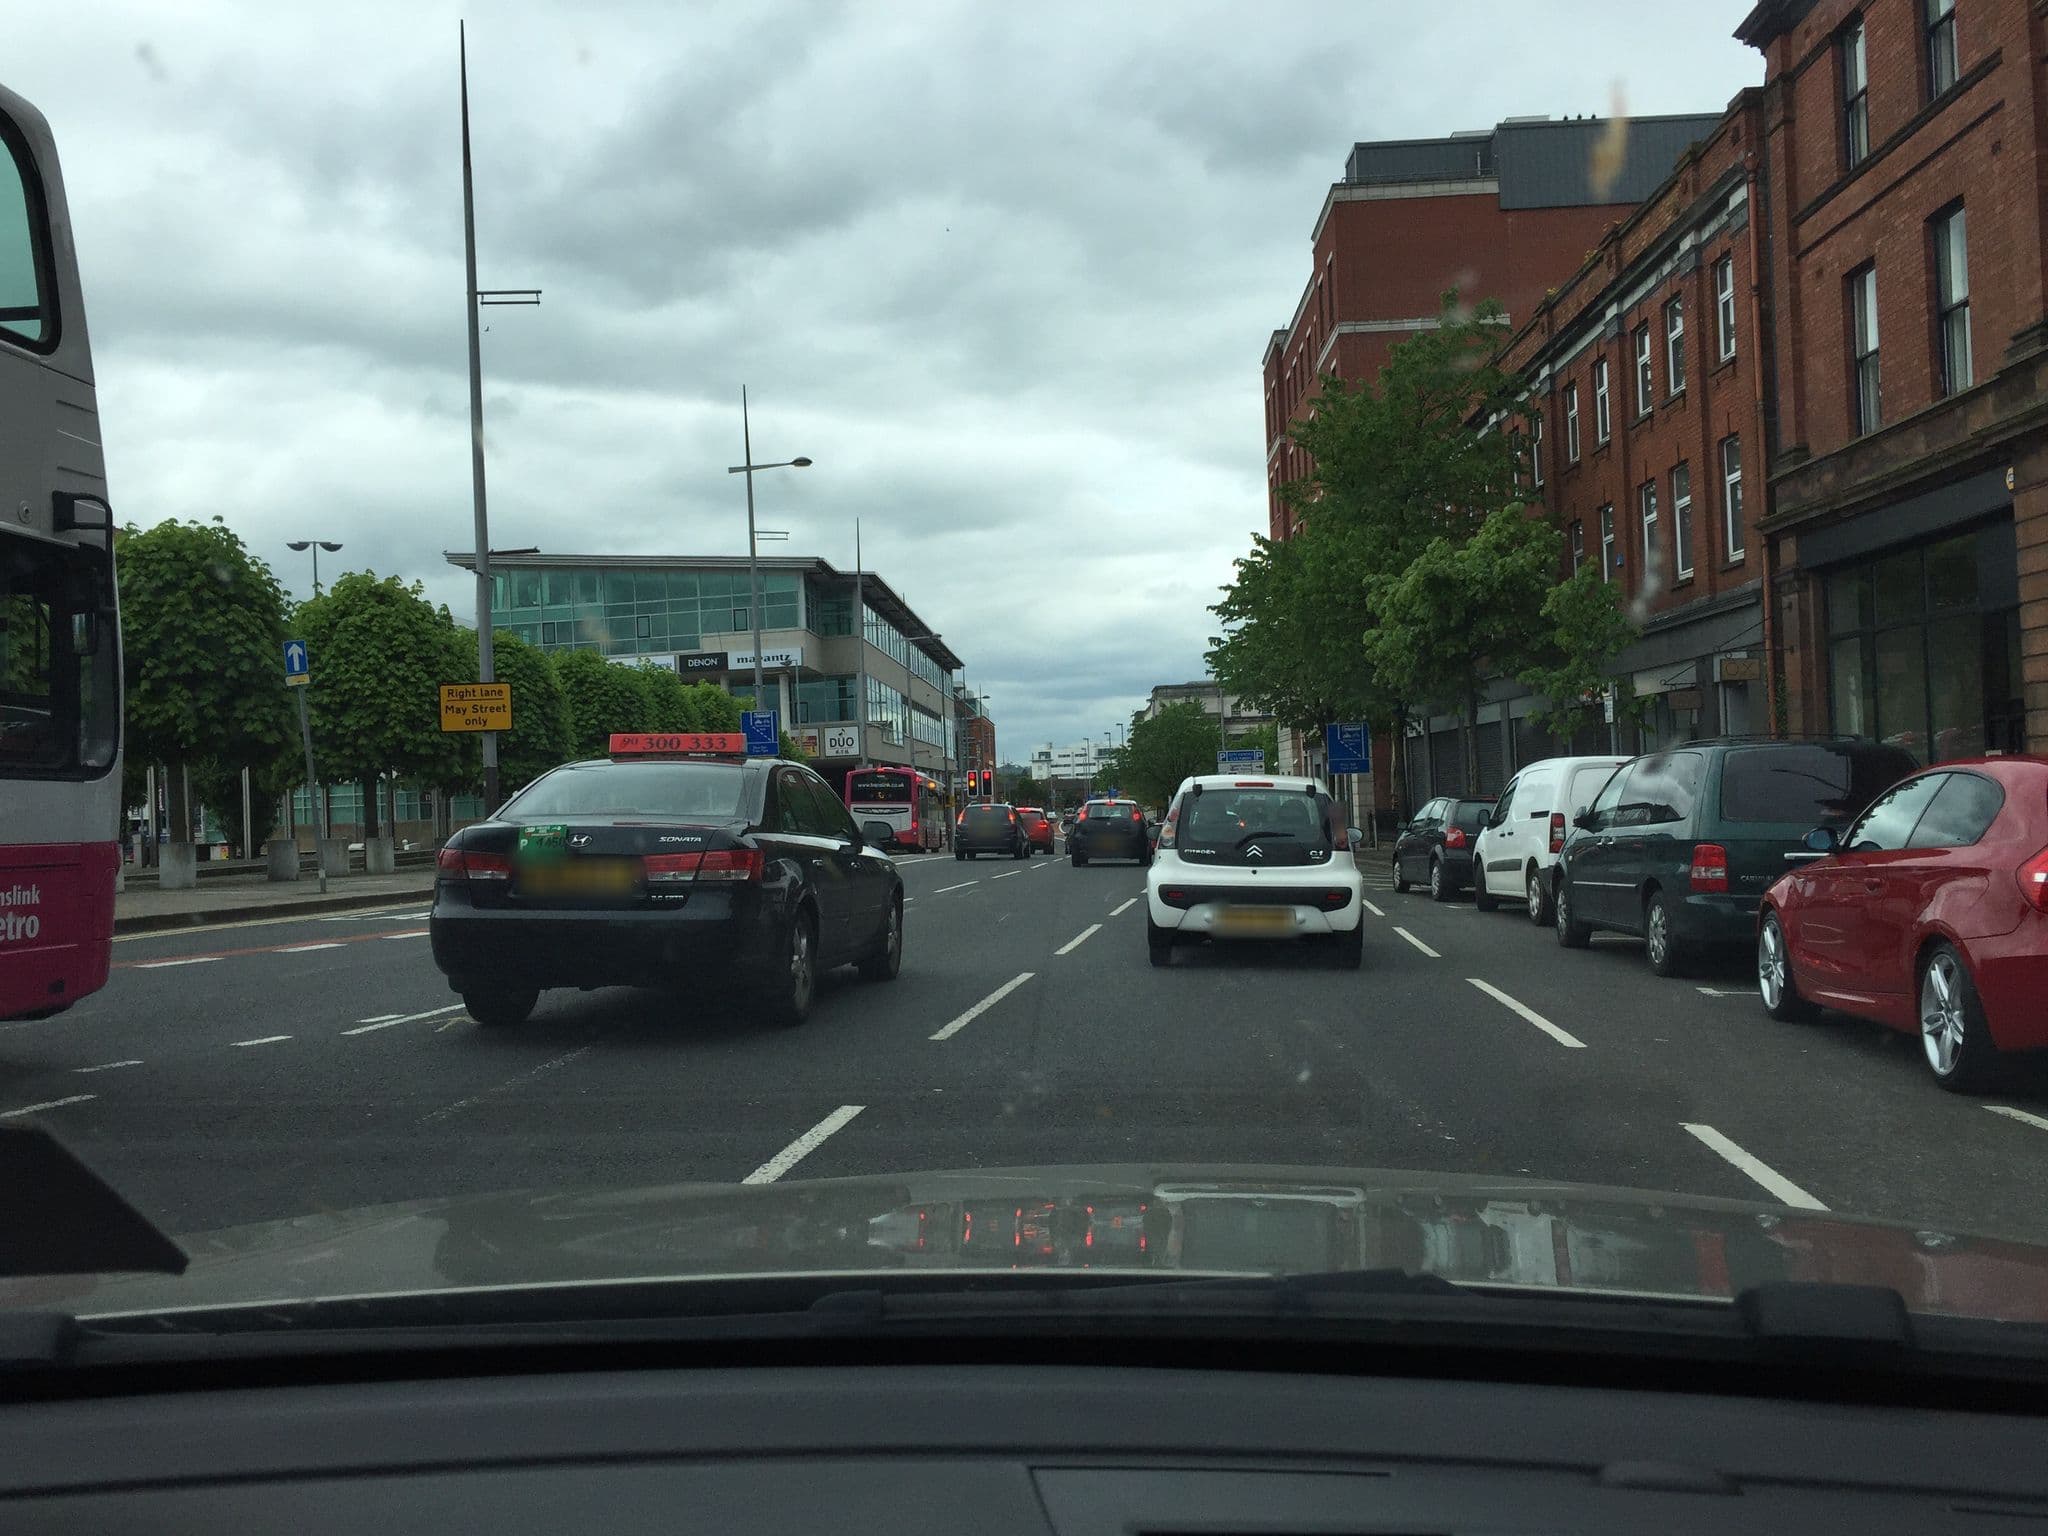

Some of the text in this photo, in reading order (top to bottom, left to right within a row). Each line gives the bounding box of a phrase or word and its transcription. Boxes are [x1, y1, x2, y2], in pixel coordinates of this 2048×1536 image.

[687, 657, 718, 668] DENON
[736, 653, 792, 664] maantz
[447, 688, 504, 699] Right lane
[445, 703, 507, 716] May Street
[464, 716, 488, 727] only
[642, 736, 681, 750] 300
[688, 736, 727, 750] 333
[829, 736, 855, 748] DUO
